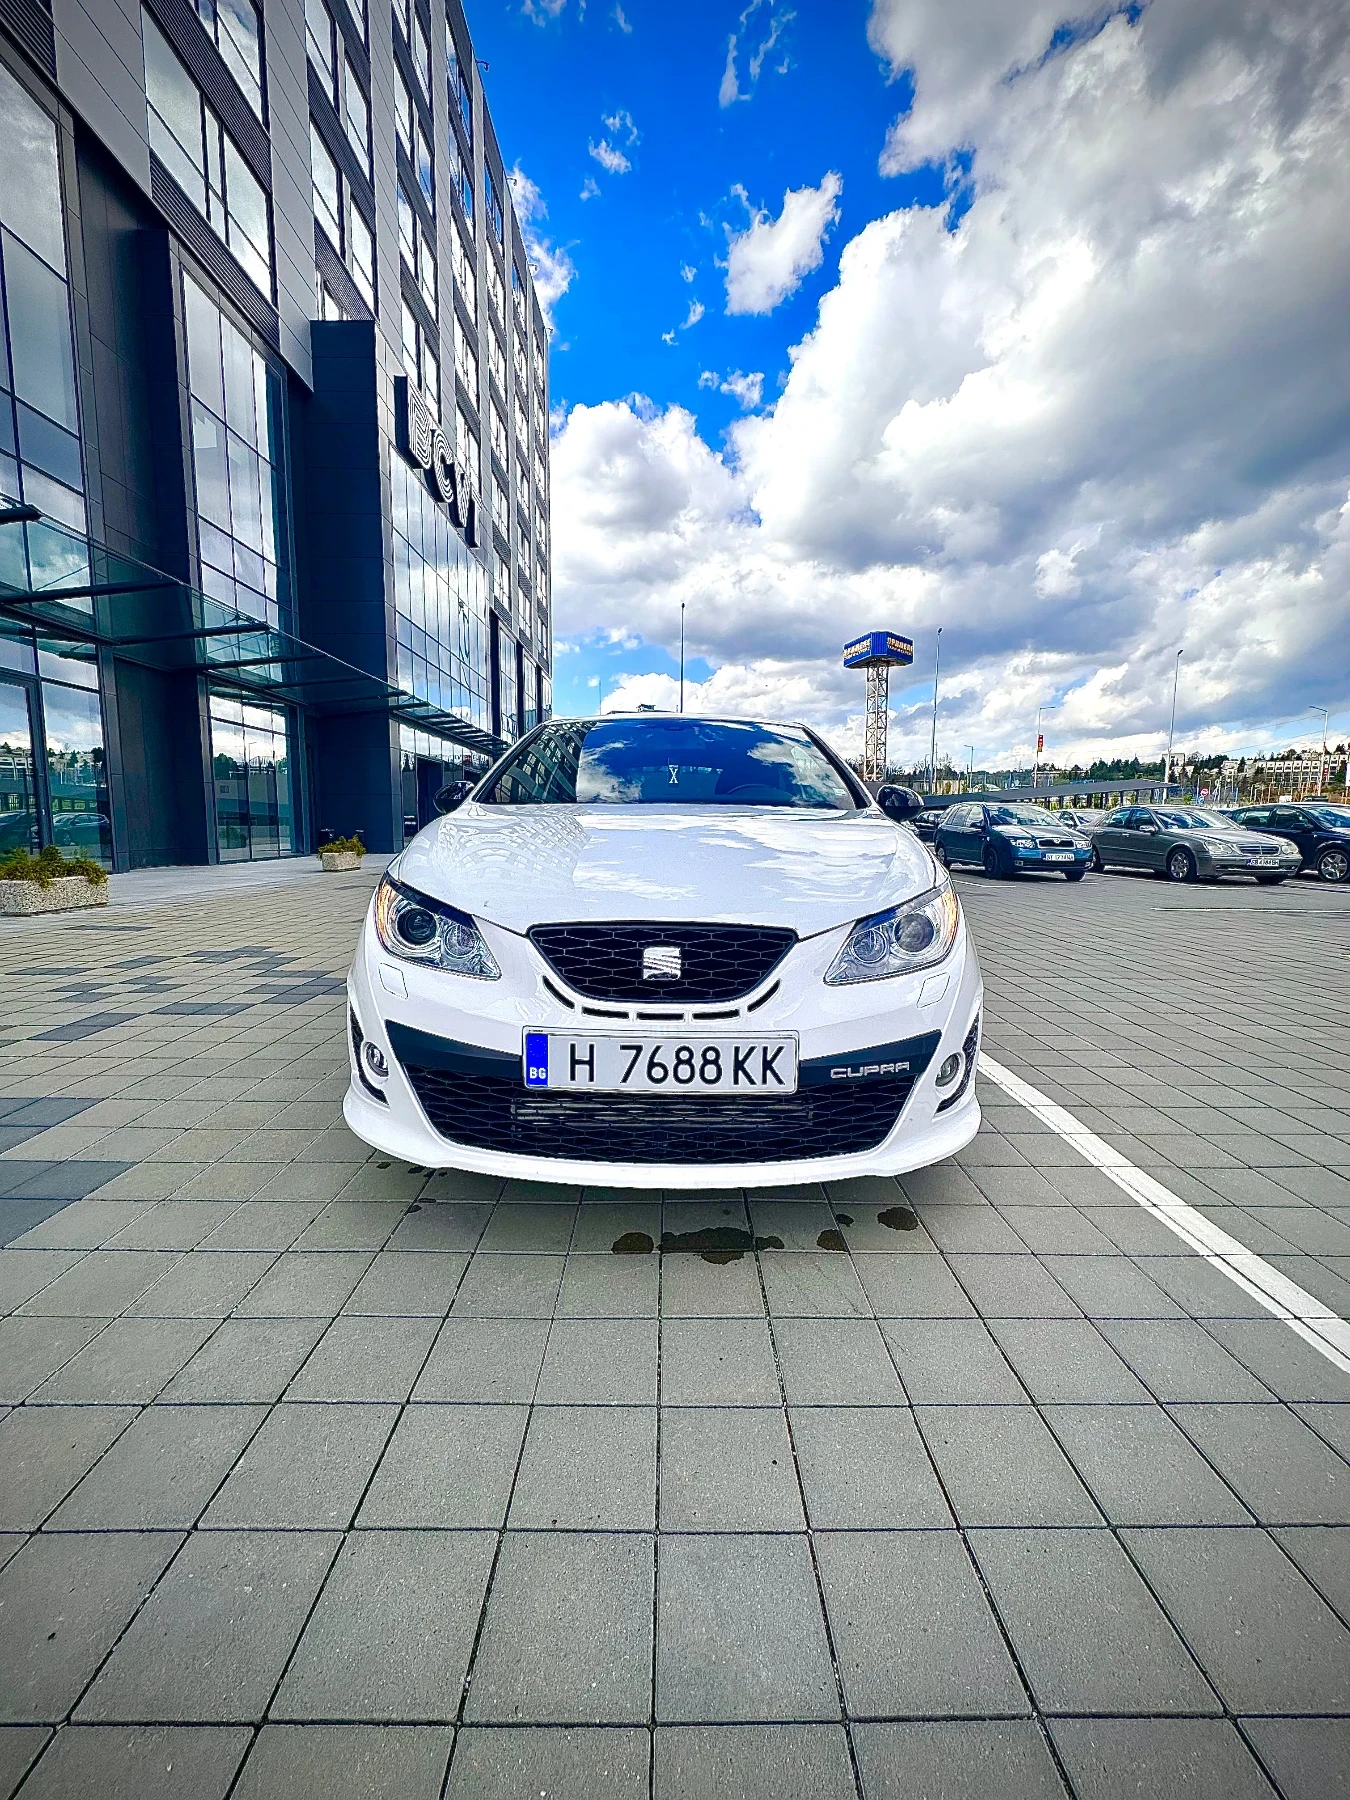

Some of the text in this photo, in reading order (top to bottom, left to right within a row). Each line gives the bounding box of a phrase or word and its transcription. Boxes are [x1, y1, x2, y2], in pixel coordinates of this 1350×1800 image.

[570, 1043, 595, 1082] H
[830, 1061, 910, 1079] CUPRA
[529, 1066, 546, 1079] BG
